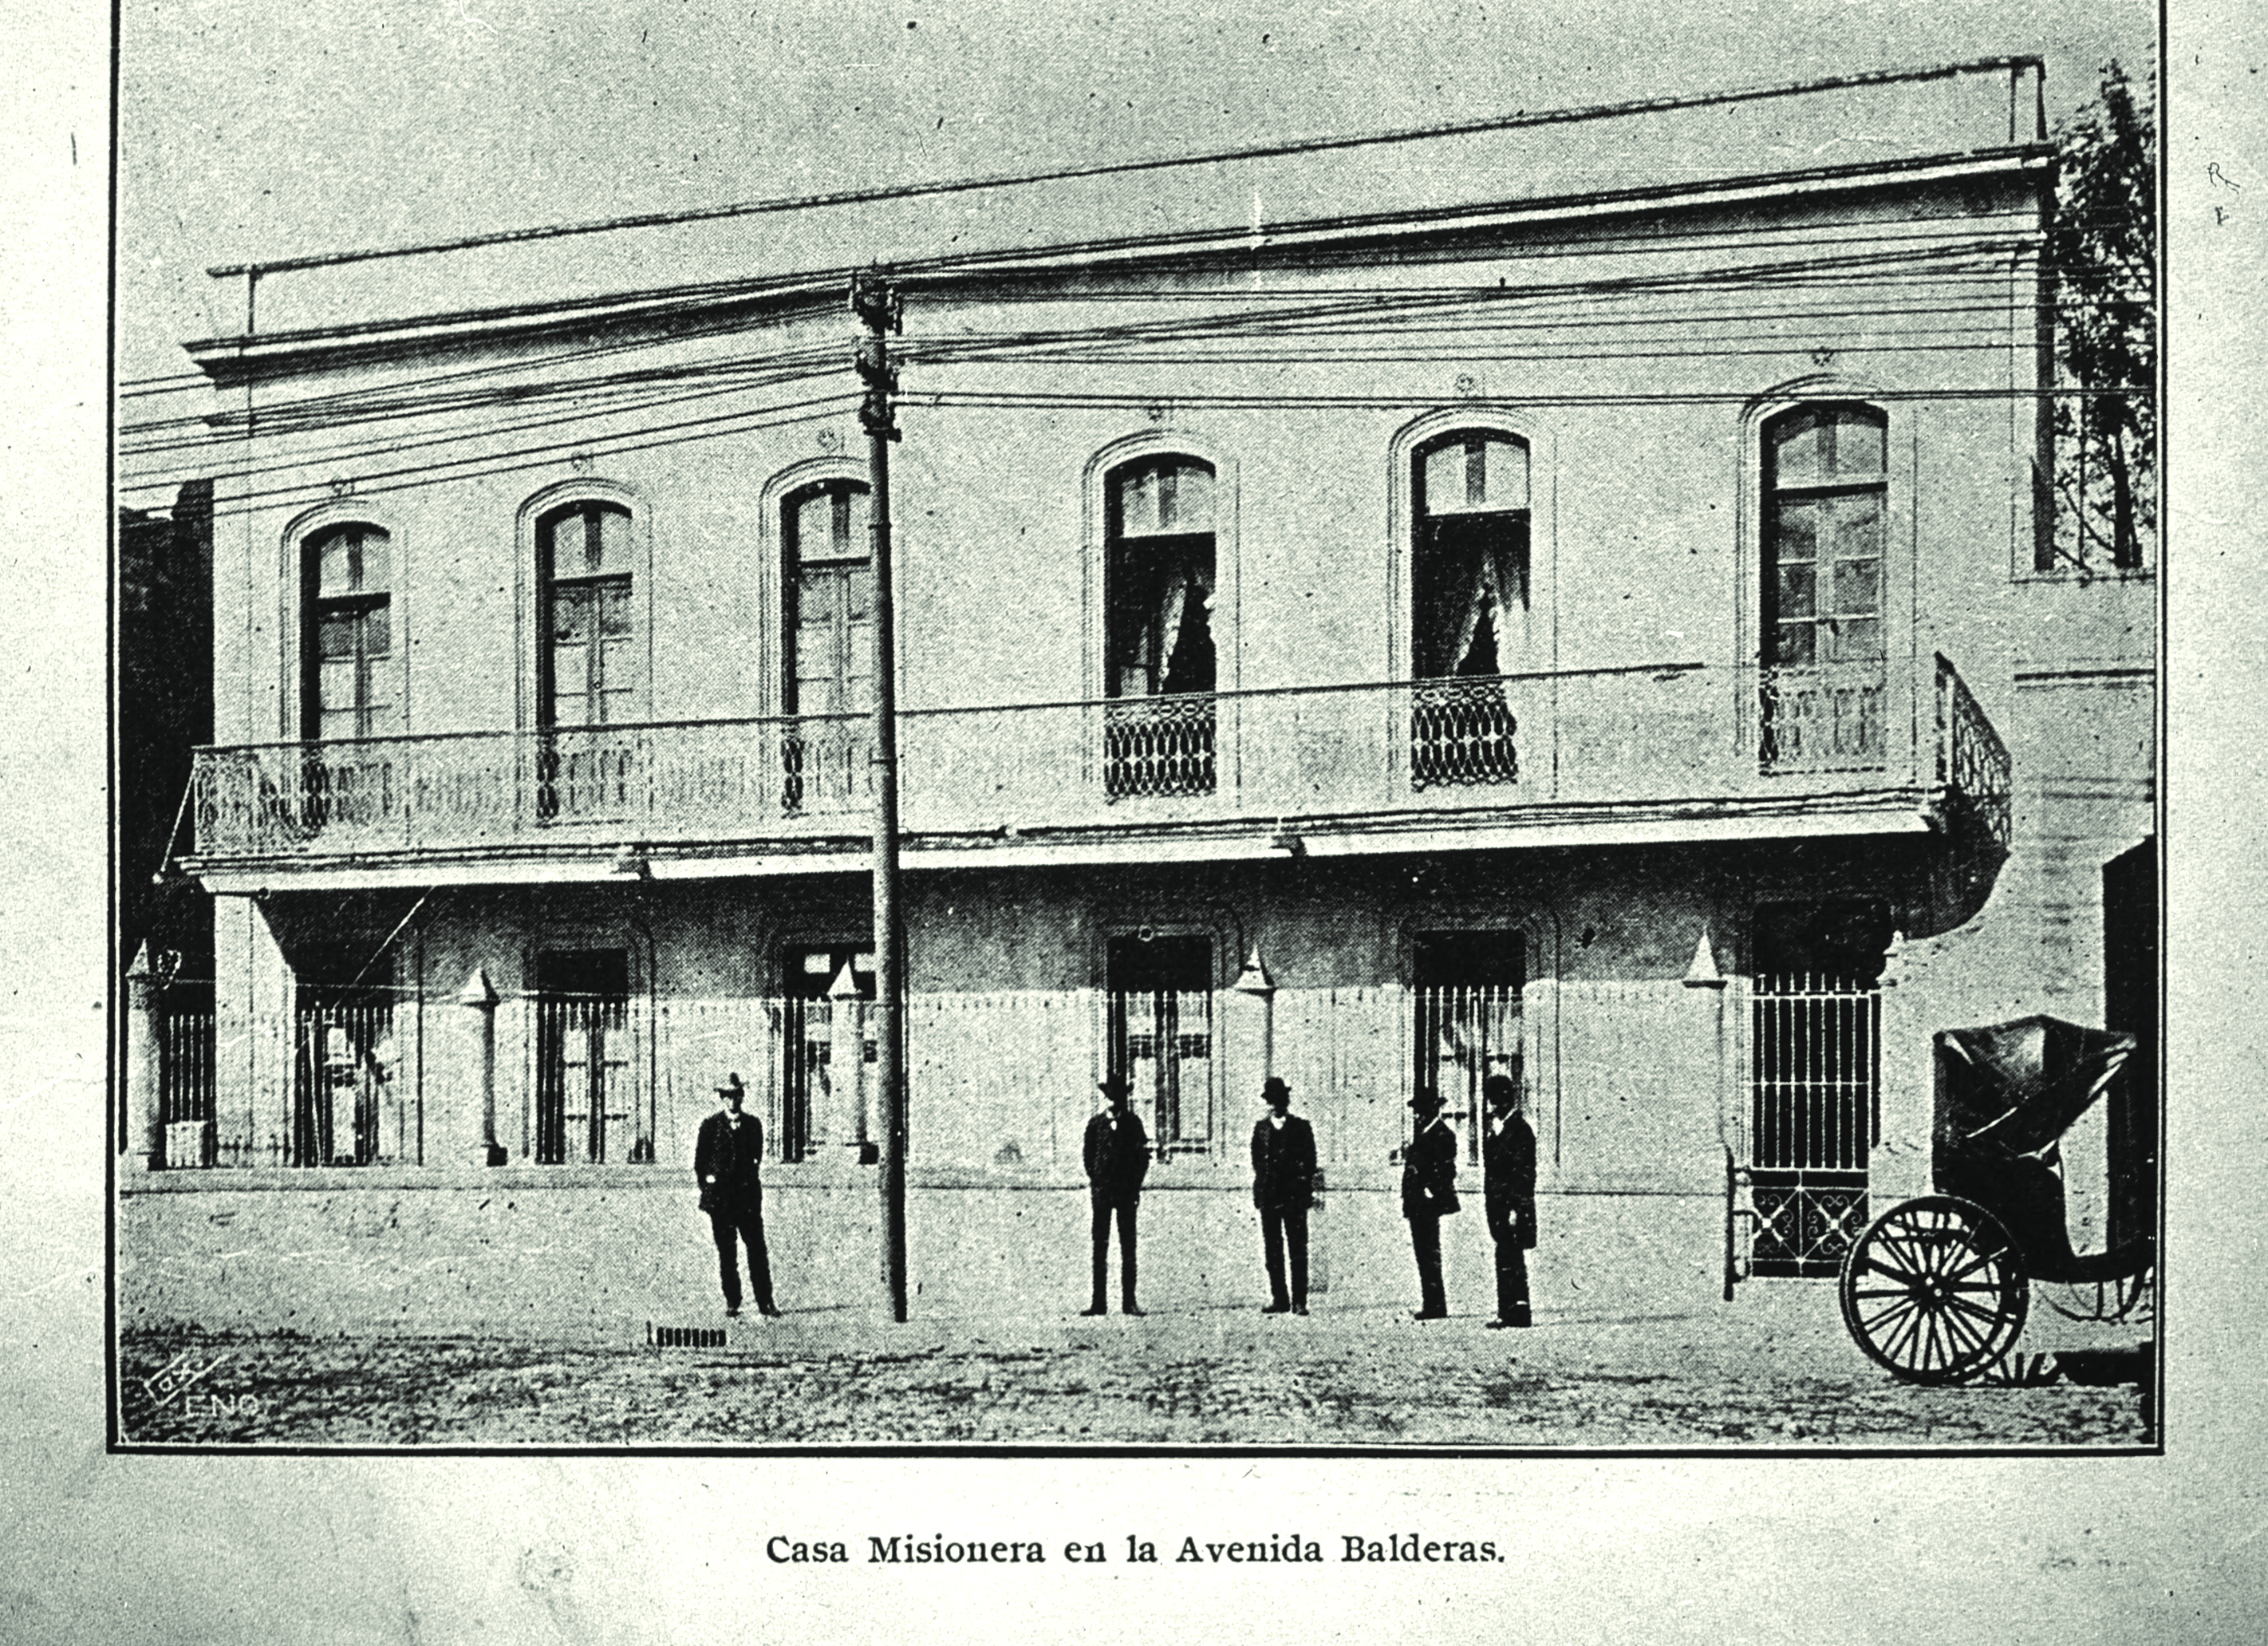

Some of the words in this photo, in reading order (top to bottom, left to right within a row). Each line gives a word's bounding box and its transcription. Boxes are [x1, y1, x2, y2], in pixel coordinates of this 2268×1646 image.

[766, 1535, 850, 1564] Casa
[867, 1533, 1047, 1564] Misionera
[1063, 1541, 1107, 1564] en
[1126, 1534, 1158, 1564] la
[1174, 1533, 1324, 1563] Avenida
[1340, 1533, 1505, 1564] Balderas.
